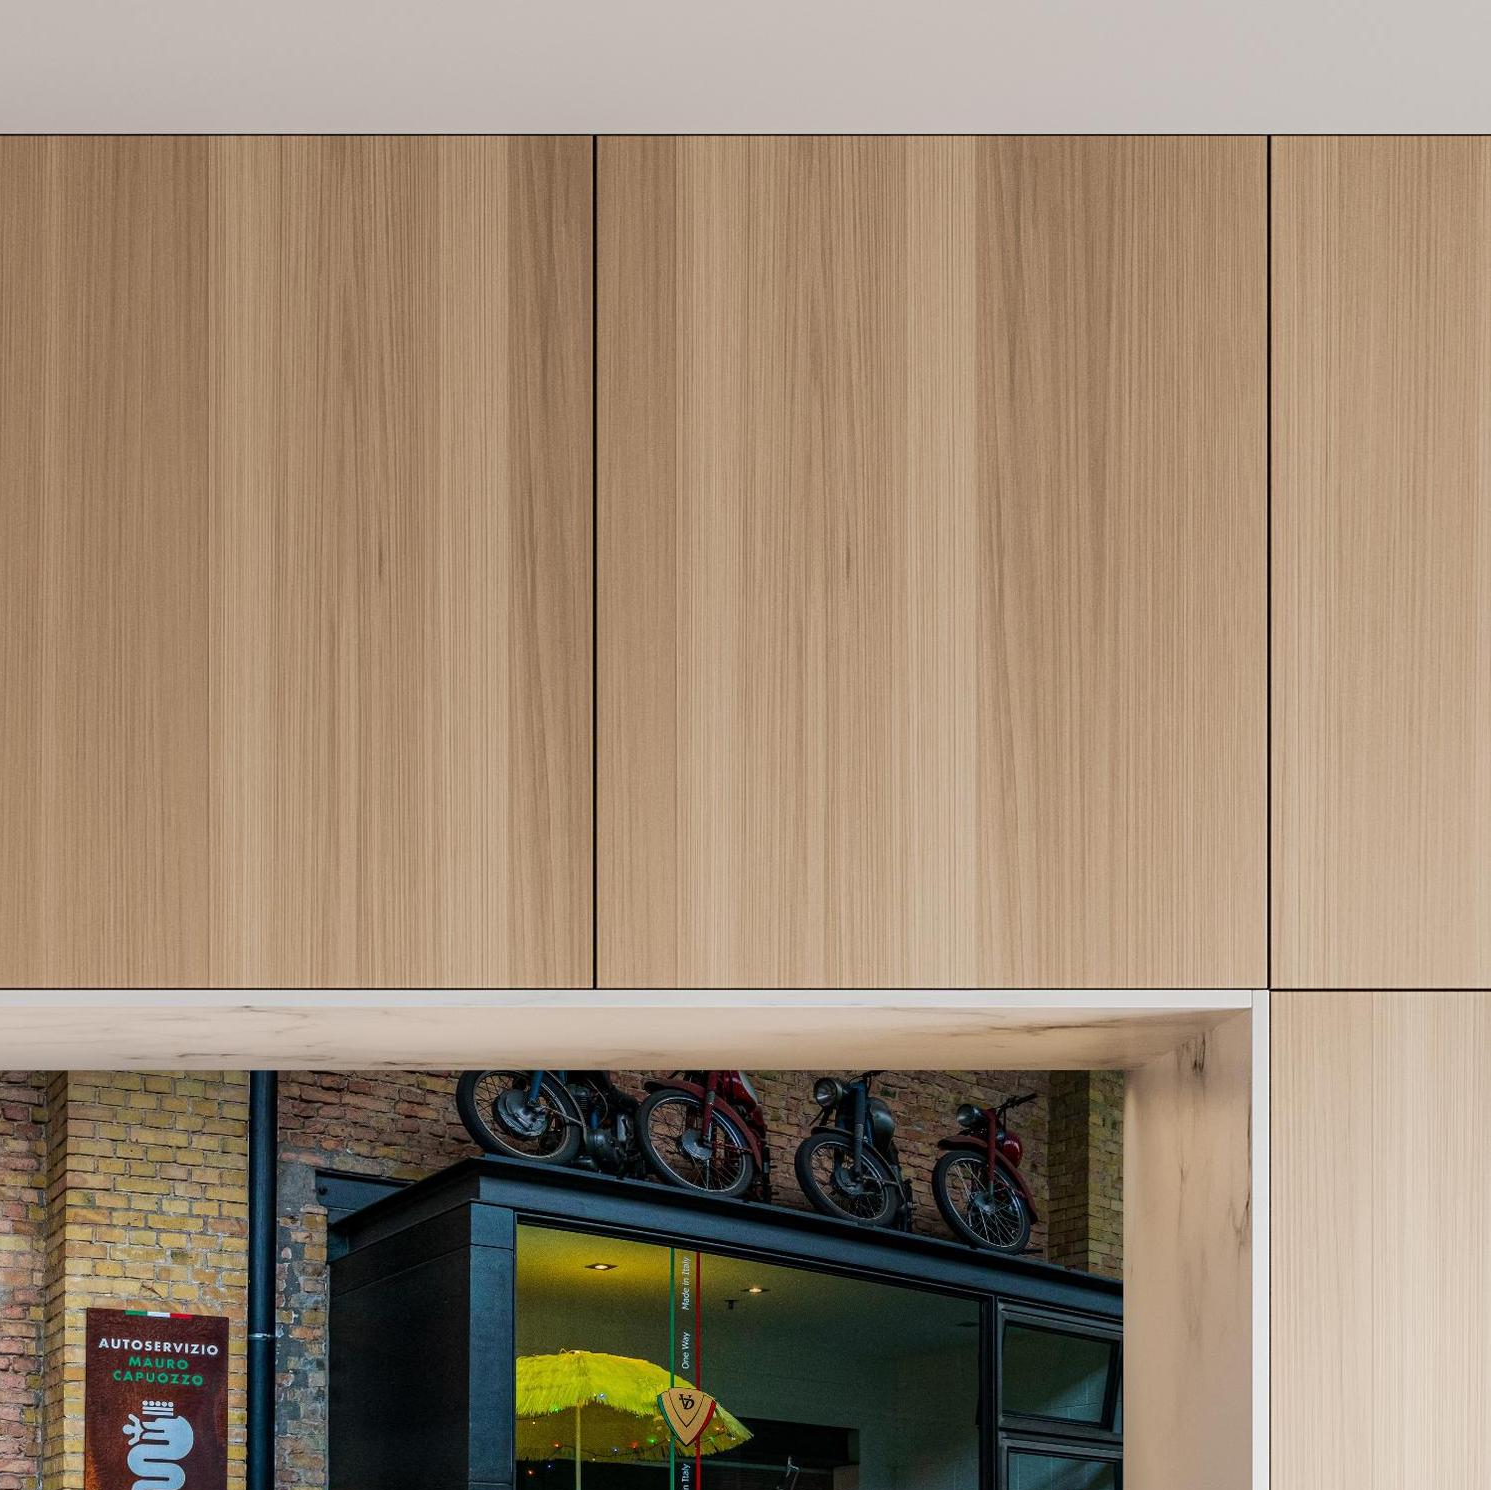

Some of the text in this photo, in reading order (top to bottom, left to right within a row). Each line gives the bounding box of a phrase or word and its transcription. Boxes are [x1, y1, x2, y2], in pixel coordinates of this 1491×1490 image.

[682, 1256, 691, 1275] Italy
[682, 1287, 690, 1311] Made
[98, 1338, 219, 1356] AUTOSERVIZIO
[682, 1331, 691, 1369] One Way
[128, 1356, 189, 1370] MAURO
[112, 1370, 204, 1387] CAPUOZZO
[682, 1463, 691, 1482] Italy
